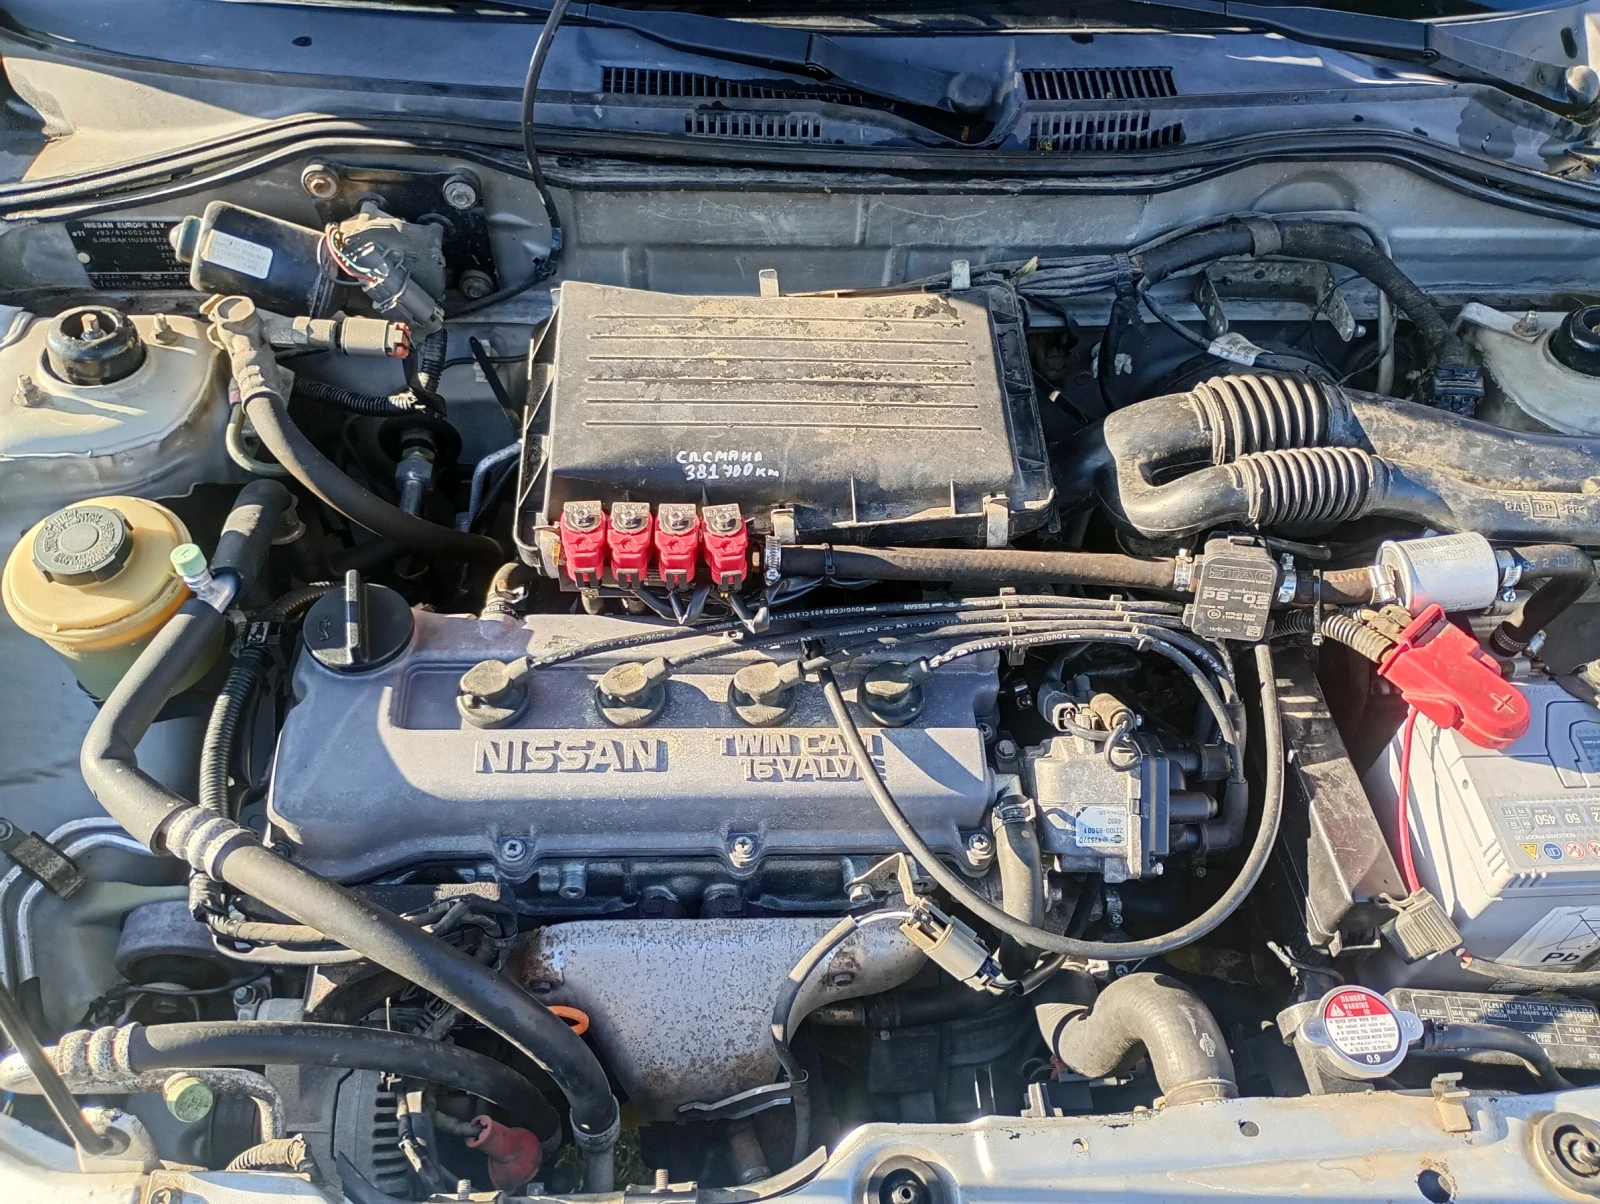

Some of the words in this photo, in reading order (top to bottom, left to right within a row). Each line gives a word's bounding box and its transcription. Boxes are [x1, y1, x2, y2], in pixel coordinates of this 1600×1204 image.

[685, 463, 719, 481] 381
[1208, 565, 1273, 582] STAG
[1202, 590, 1270, 605] PS-02
[713, 733, 796, 757] TWIN
[474, 738, 664, 774] NISSAN
[740, 756, 883, 782] 16VALV
[1534, 814, 1556, 826] 450
[1565, 813, 1581, 824] 50
[1540, 952, 1581, 963] Pb
[1340, 993, 1367, 1003] DANGER
[1342, 1001, 1370, 1010] WARNING
[1366, 1053, 1381, 1064] 0.9
